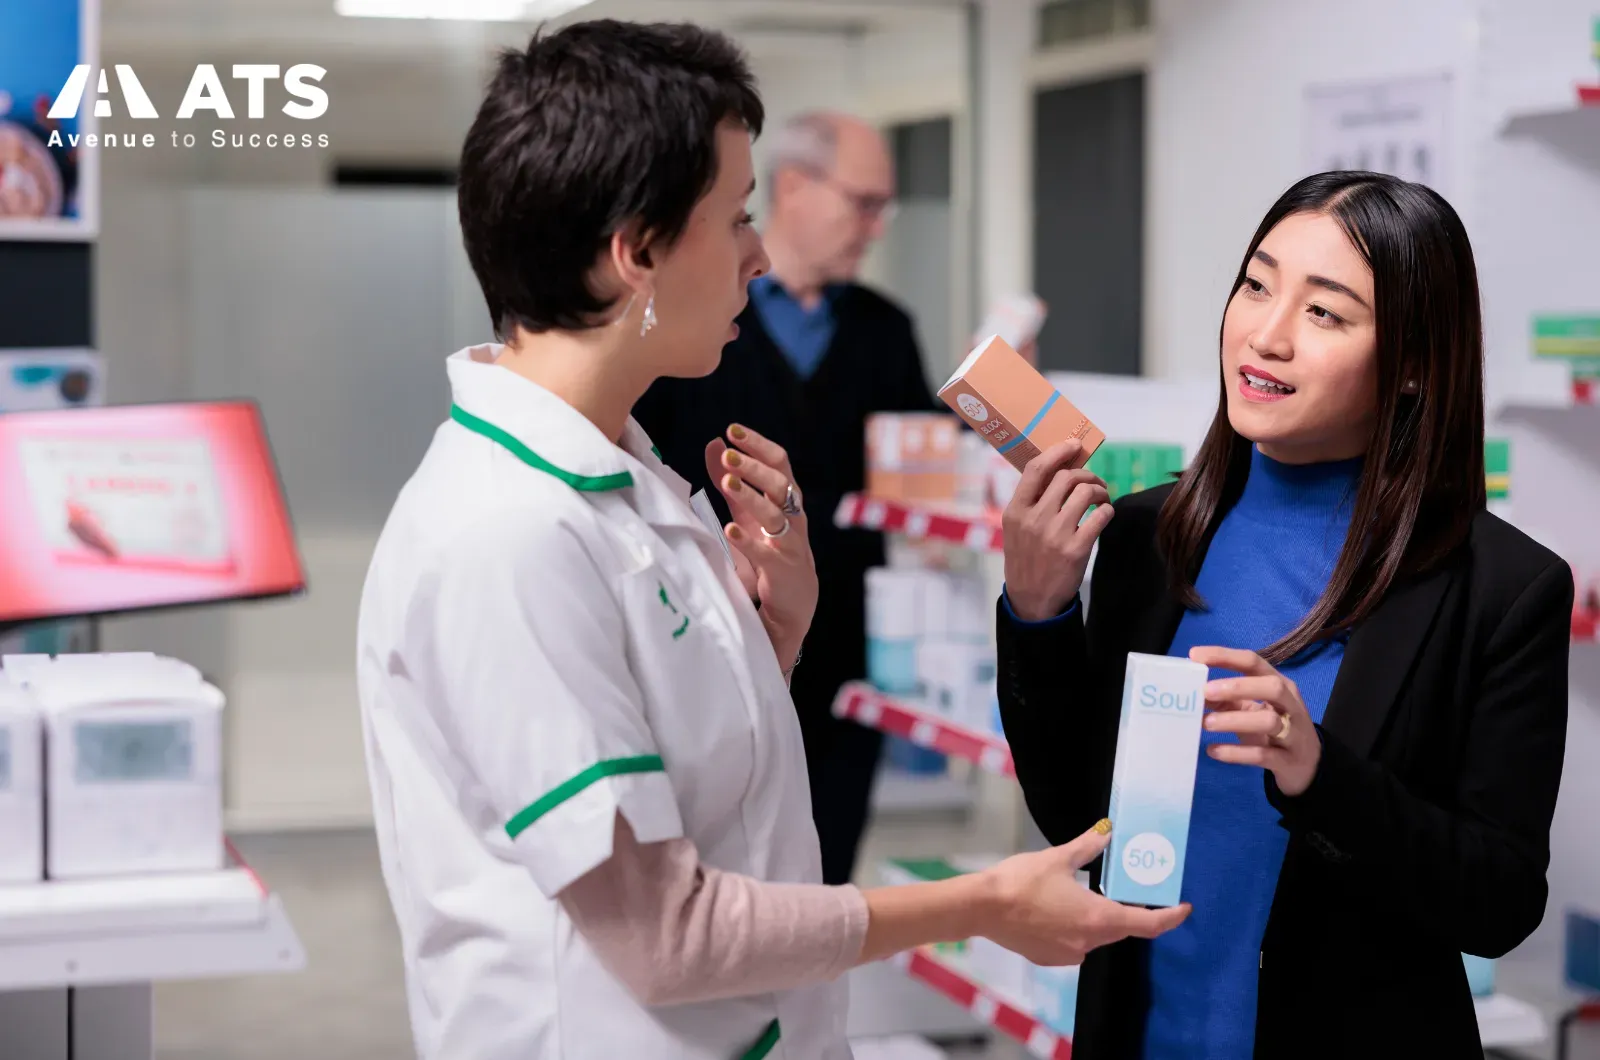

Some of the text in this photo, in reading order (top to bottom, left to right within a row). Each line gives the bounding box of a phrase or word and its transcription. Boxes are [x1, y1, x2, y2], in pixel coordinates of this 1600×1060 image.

[964, 402, 983, 417] 50+
[980, 417, 1003, 435] BLOCK
[993, 429, 1010, 441] SUN
[1140, 684, 1197, 713] Soul
[1128, 849, 1169, 869] 50+
